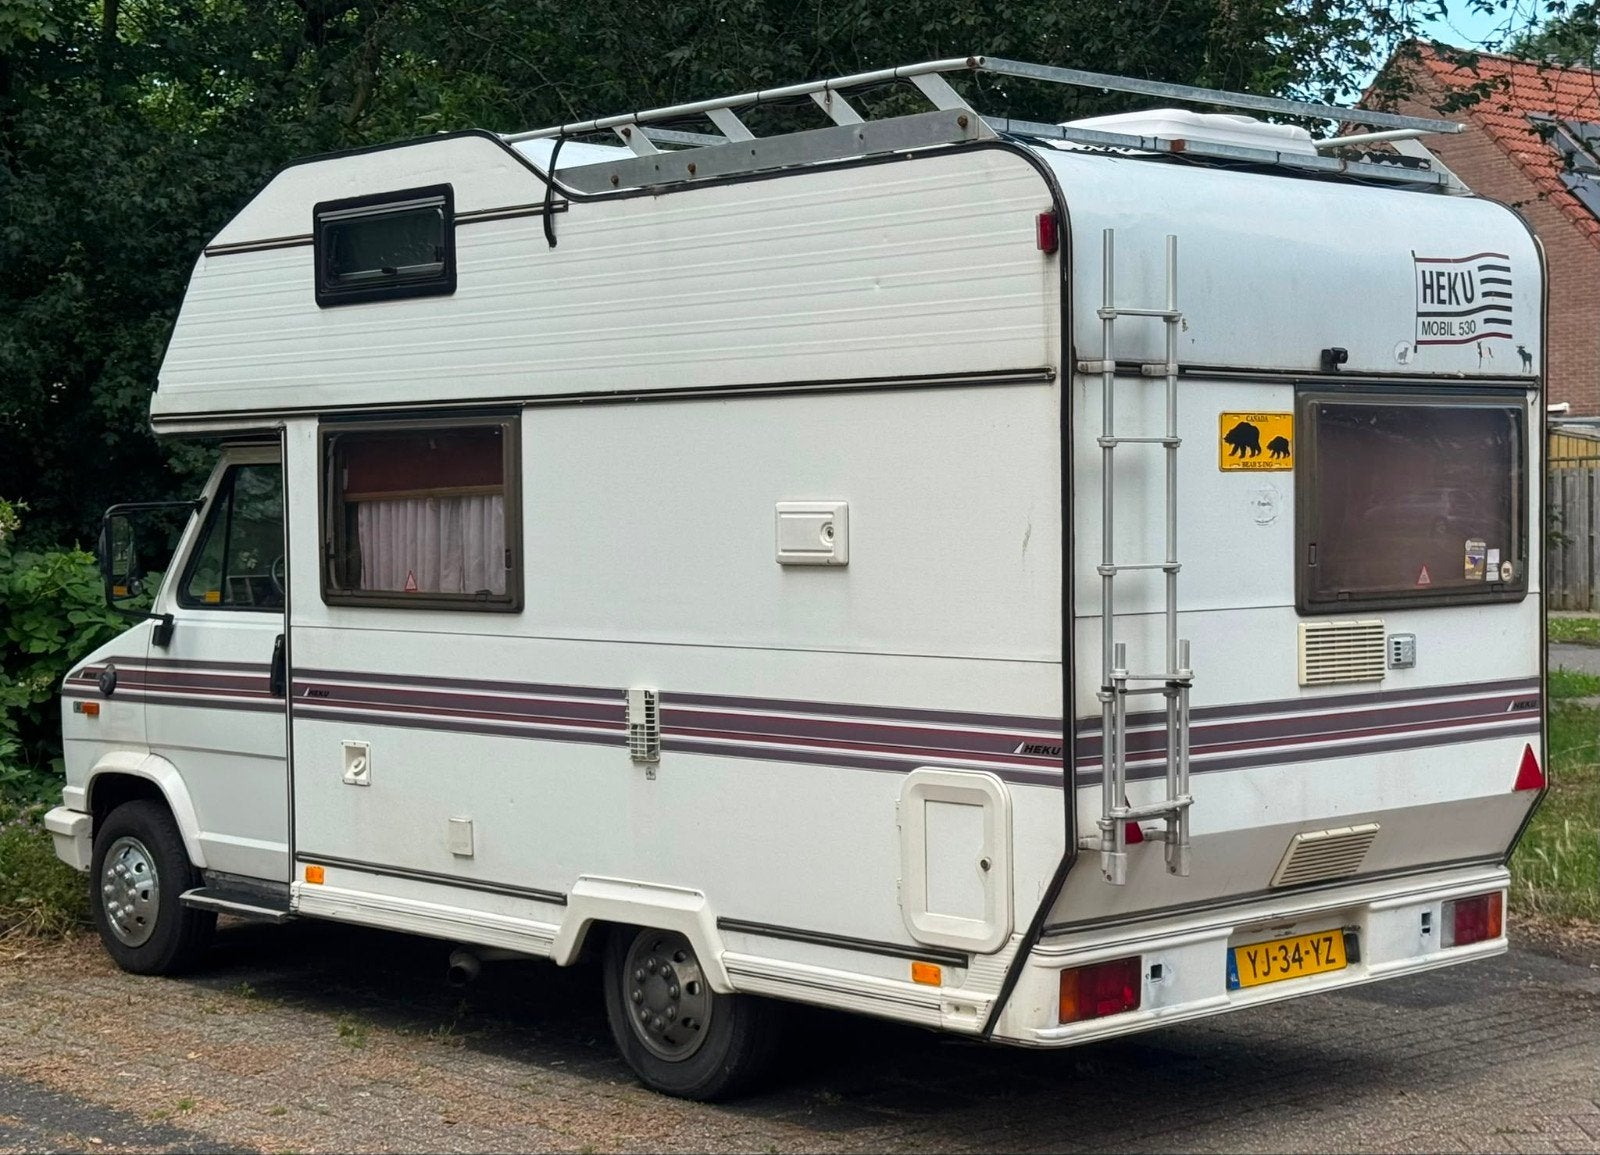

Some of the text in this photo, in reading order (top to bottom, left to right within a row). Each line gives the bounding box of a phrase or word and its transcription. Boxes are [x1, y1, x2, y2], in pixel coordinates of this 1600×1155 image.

[1421, 269, 1475, 306] HEKU
[1421, 319, 1477, 336] MOBIL 530
[1024, 744, 1061, 755] HEKU
[1246, 936, 1336, 979] YJ-34-YZ
